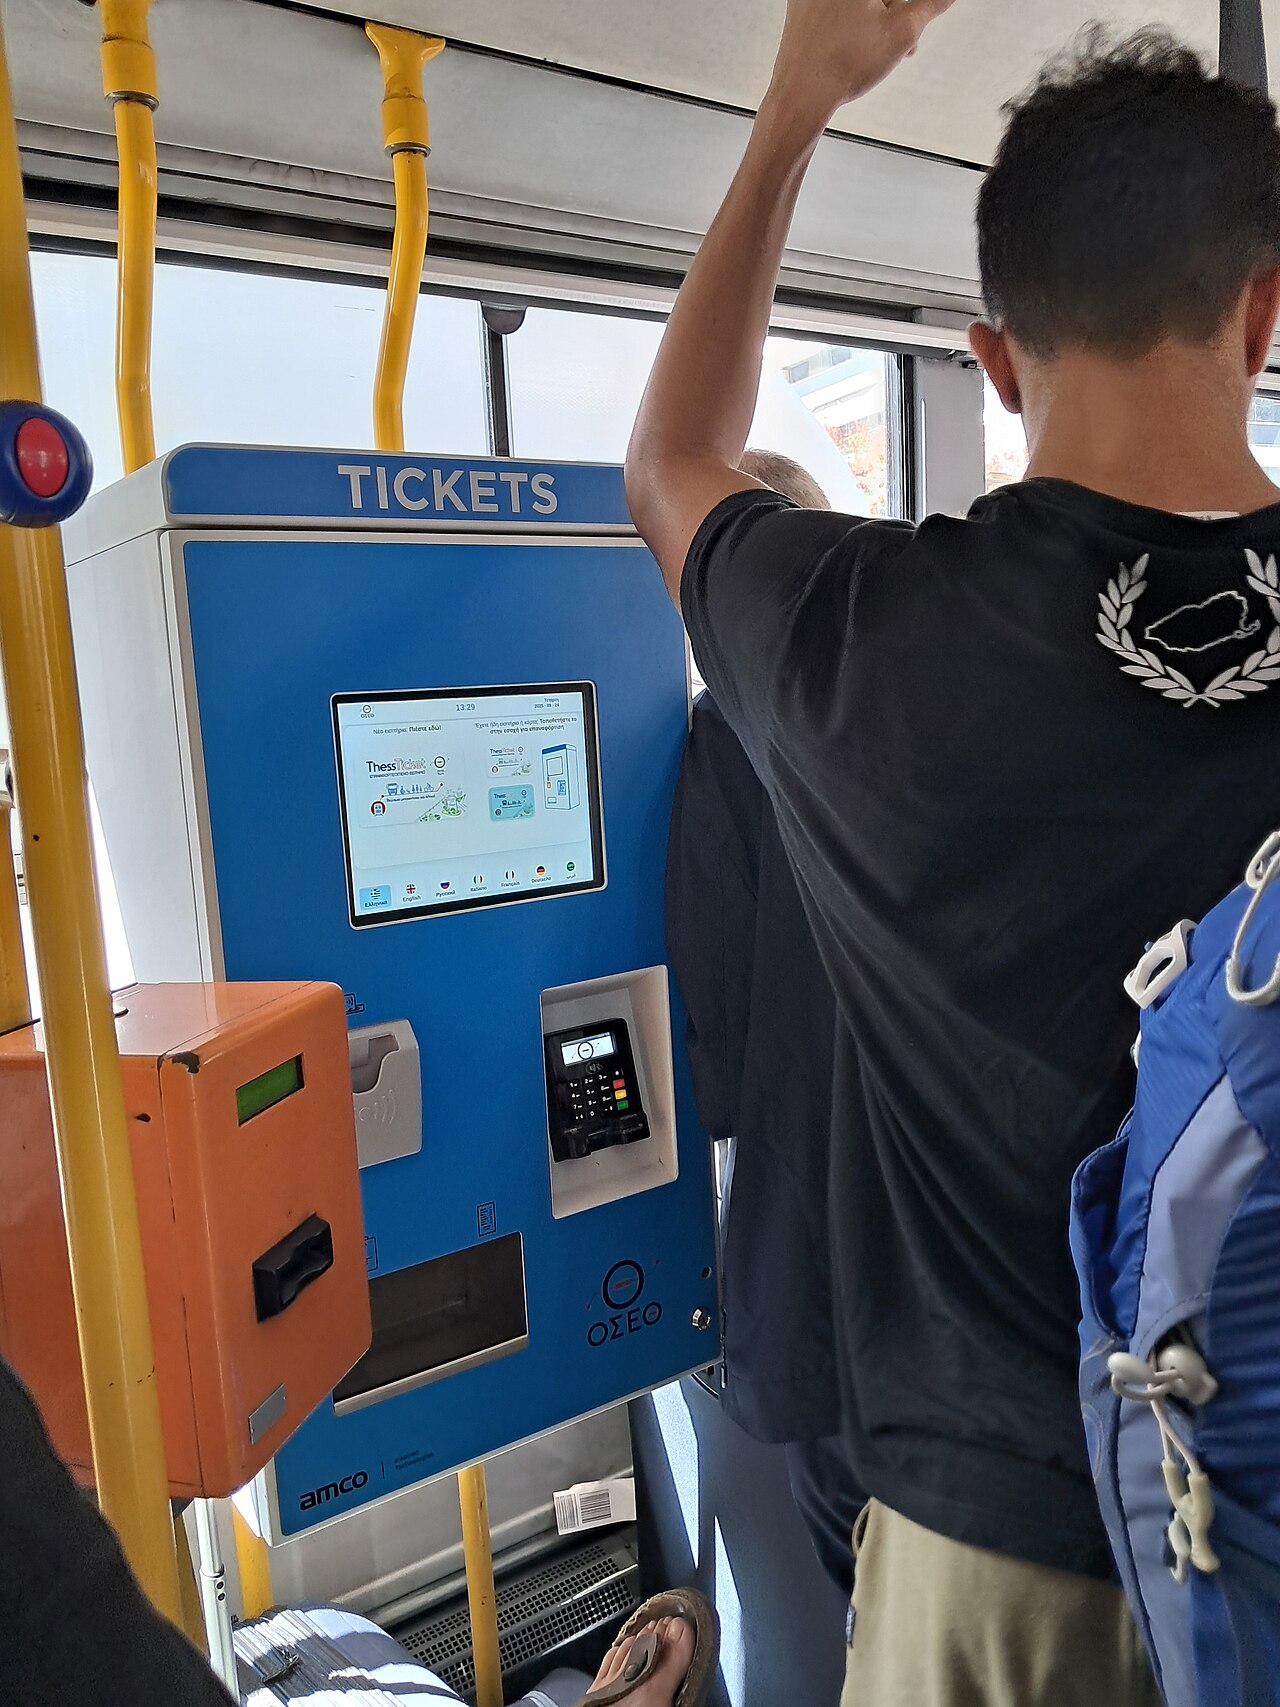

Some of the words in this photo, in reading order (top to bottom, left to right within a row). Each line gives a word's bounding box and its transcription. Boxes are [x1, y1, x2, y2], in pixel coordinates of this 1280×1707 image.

[338, 465, 558, 514] TICKETS
[456, 703, 475, 711] 13:29
[300, 1471, 368, 1511] amco
